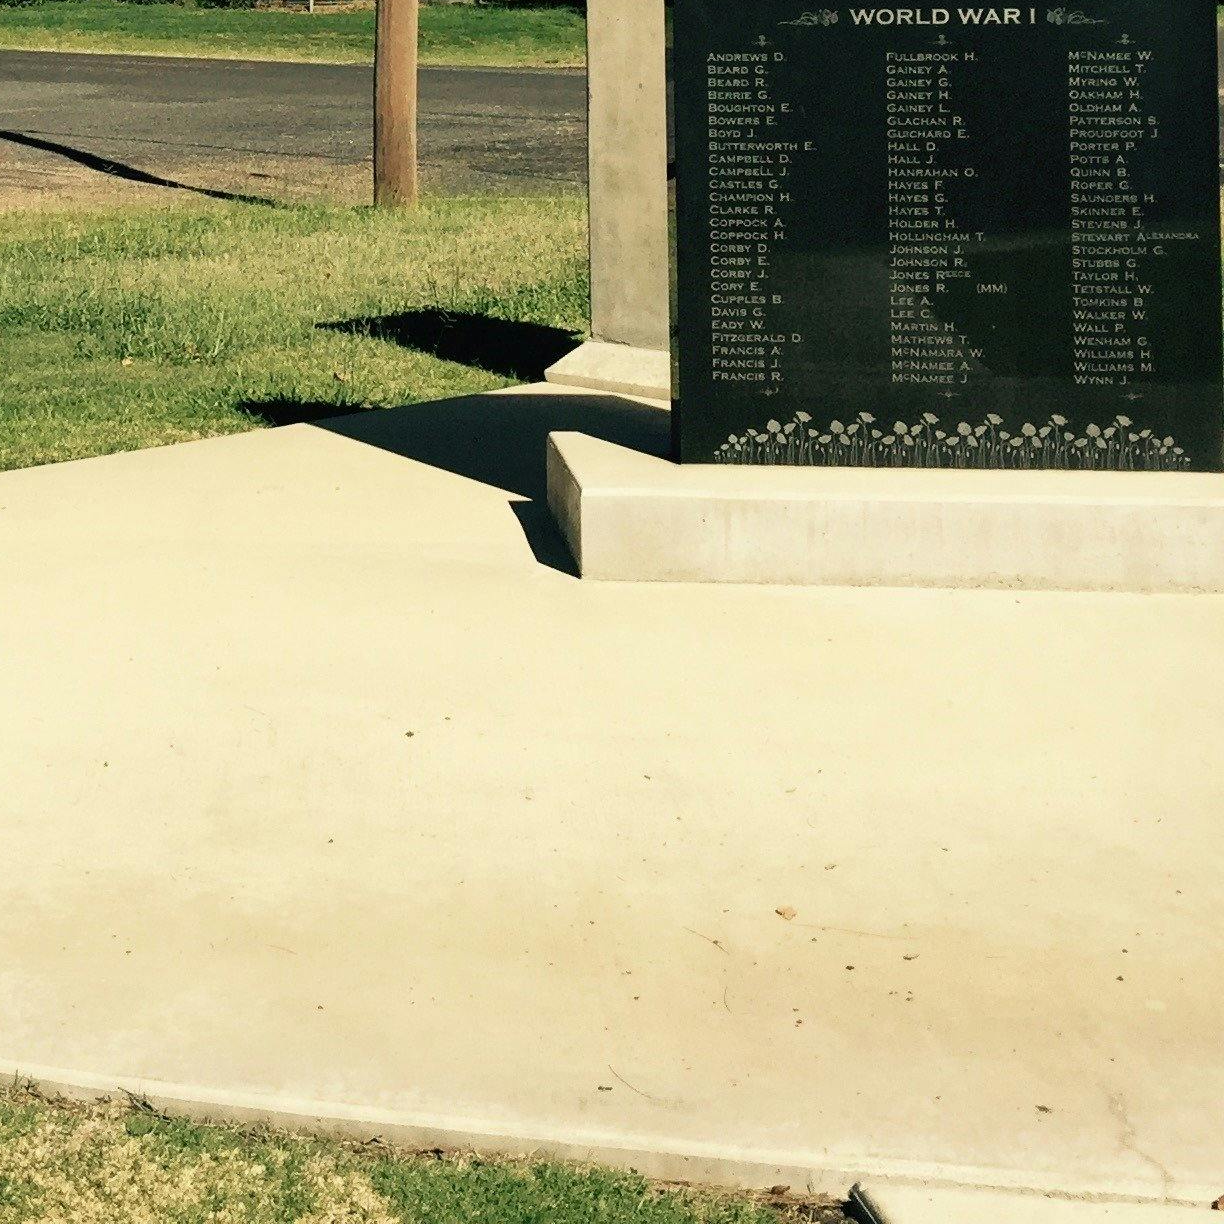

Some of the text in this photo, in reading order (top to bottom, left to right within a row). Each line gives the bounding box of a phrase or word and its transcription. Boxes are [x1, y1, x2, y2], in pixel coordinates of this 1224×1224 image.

[849, 8, 1035, 25] WORLD WAR I
[707, 53, 768, 61] ANDREWS
[886, 52, 958, 61] FULLBROOK
[707, 65, 749, 74] BEARD
[886, 65, 932, 74] GAINEY
[1068, 64, 1130, 73] MITCHELL
[708, 78, 749, 86] BEARD
[886, 78, 932, 86] GAINEY
[1068, 77, 1117, 86] MYRING
[708, 91, 751, 99] BERRIE
[886, 91, 932, 99] GAINEY
[708, 104, 775, 112] BOUGHTON
[886, 104, 933, 112] GAINEY
[1069, 104, 1122, 112] OLDHAM
[708, 116, 760, 125] BOWERS
[1069, 116, 1141, 125] PATTERSON
[708, 129, 741, 137] BOYD
[708, 142, 798, 150] BUTTERWORTH
[888, 143, 920, 151] HALL
[1070, 142, 1119, 150] PORTER
[709, 155, 773, 163] CAMPBELL
[888, 156, 920, 164] HALL
[1070, 155, 1109, 163] POTTS
[709, 167, 773, 176] CAMPBELL
[888, 168, 958, 176] HANRAHAN
[1070, 168, 1110, 176] QUINN
[709, 180, 763, 188] CASTLES
[888, 181, 928, 189] HAYES
[709, 193, 773, 201] CHAMPION
[889, 194, 928, 202] HAYES
[1071, 194, 1137, 202] SAUNDERS
[709, 206, 758, 214] CLARKE
[889, 207, 929, 215] HAYES
[1071, 207, 1125, 215] SKINNER
[709, 218, 767, 226] COPPOCK
[889, 220, 938, 228] HOLDER
[1072, 220, 1127, 228] STEVENS
[710, 231, 768, 239] COPPOCK
[889, 233, 970, 241] HOLLINGHAM
[1071, 232, 1130, 241] STEWART
[710, 244, 751, 252] CORBY
[890, 245, 948, 254] JOHNSON
[710, 256, 751, 265] CORBY
[891, 258, 947, 266] JOHNSON
[1072, 259, 1119, 267] STUBBS
[710, 269, 751, 278] CORBY
[889, 271, 929, 279] JONES
[1072, 272, 1118, 280] TAYLOR
[711, 282, 744, 290] CORY
[890, 284, 929, 292] JONES
[976, 283, 1008, 294] (MM)
[711, 295, 766, 303] CUPPLES
[890, 296, 914, 305] LEE
[711, 307, 747, 316] DAVIS
[891, 310, 914, 318] LEE
[1073, 311, 1125, 319] WALKER
[711, 320, 744, 329] EADY
[891, 322, 938, 330] MARTIN
[1073, 323, 1108, 332] WALL
[712, 333, 785, 342] FITZGERALD
[1074, 337, 1131, 345] WENHAM
[712, 346, 765, 354] FRANCIS
[1074, 350, 1134, 358] WILLIAMS
[712, 359, 765, 367] FRANCIS
[1074, 363, 1134, 371] WILLIAMS
[712, 372, 765, 380] FRANCIS
[1074, 376, 1113, 384] WYNN
